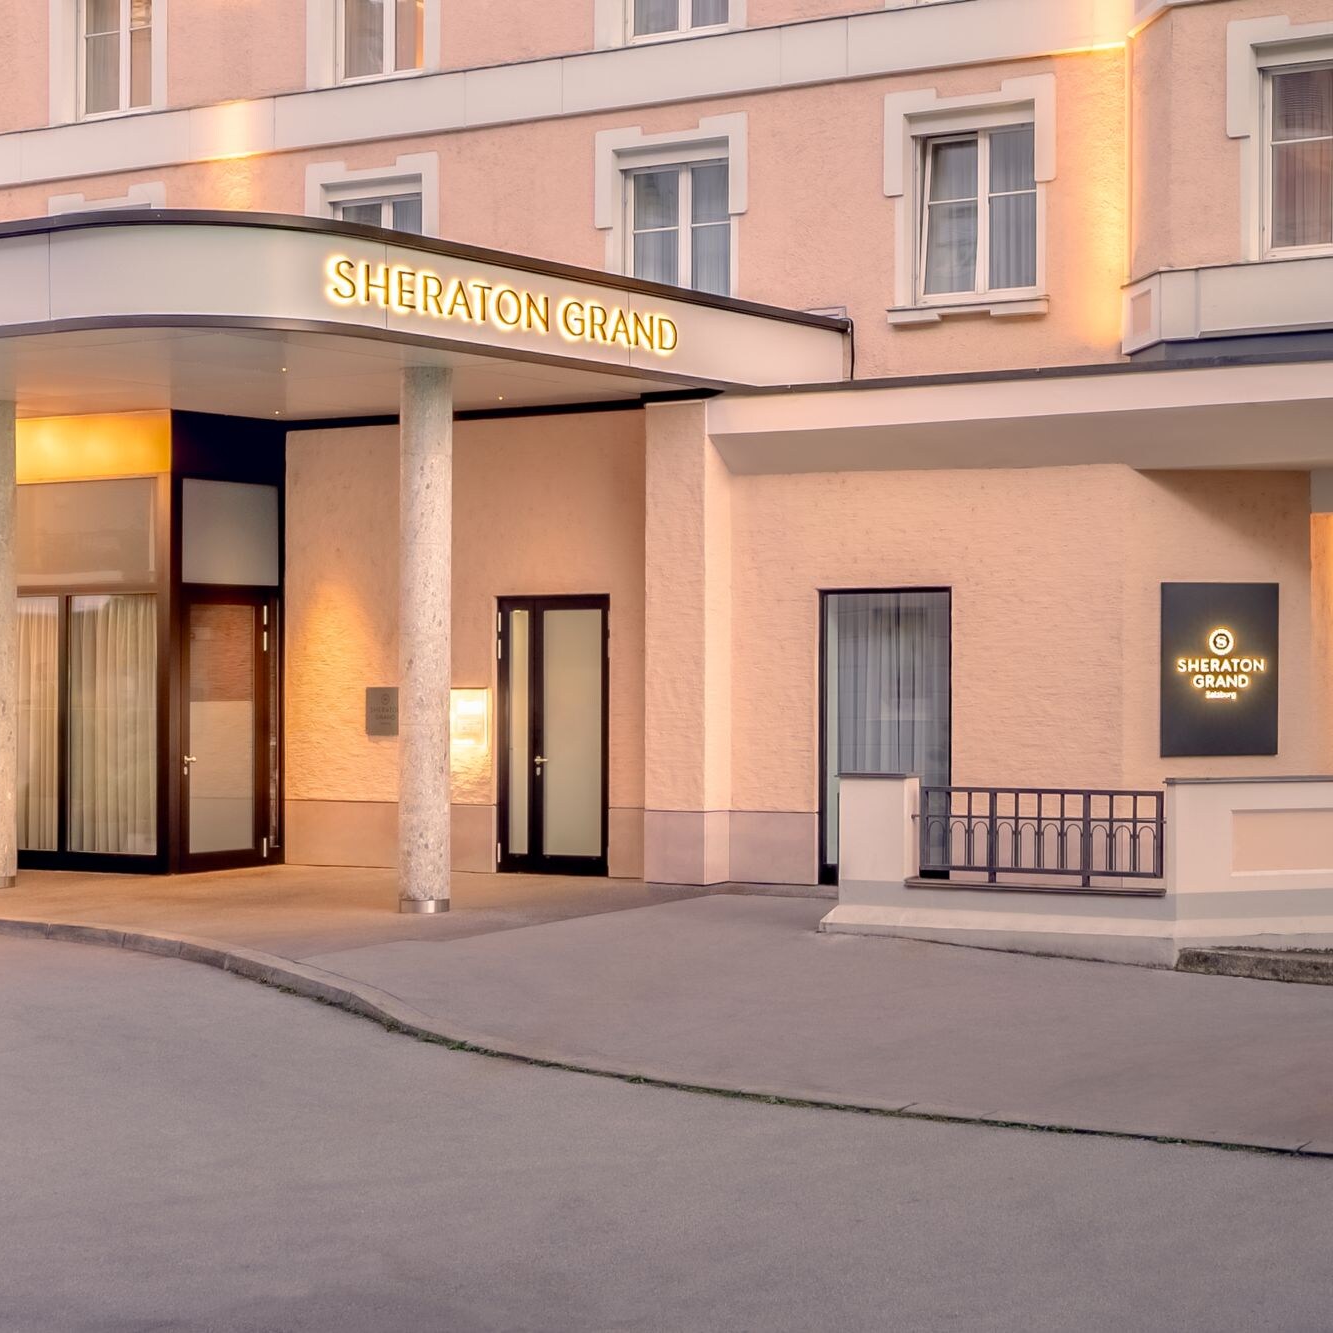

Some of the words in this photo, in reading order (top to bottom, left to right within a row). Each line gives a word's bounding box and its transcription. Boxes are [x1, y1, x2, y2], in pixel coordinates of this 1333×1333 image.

[332, 259, 550, 333] SHERATON
[562, 300, 679, 352] GRAND
[1177, 658, 1265, 673] SHERATON
[1192, 674, 1249, 688] GRAND
